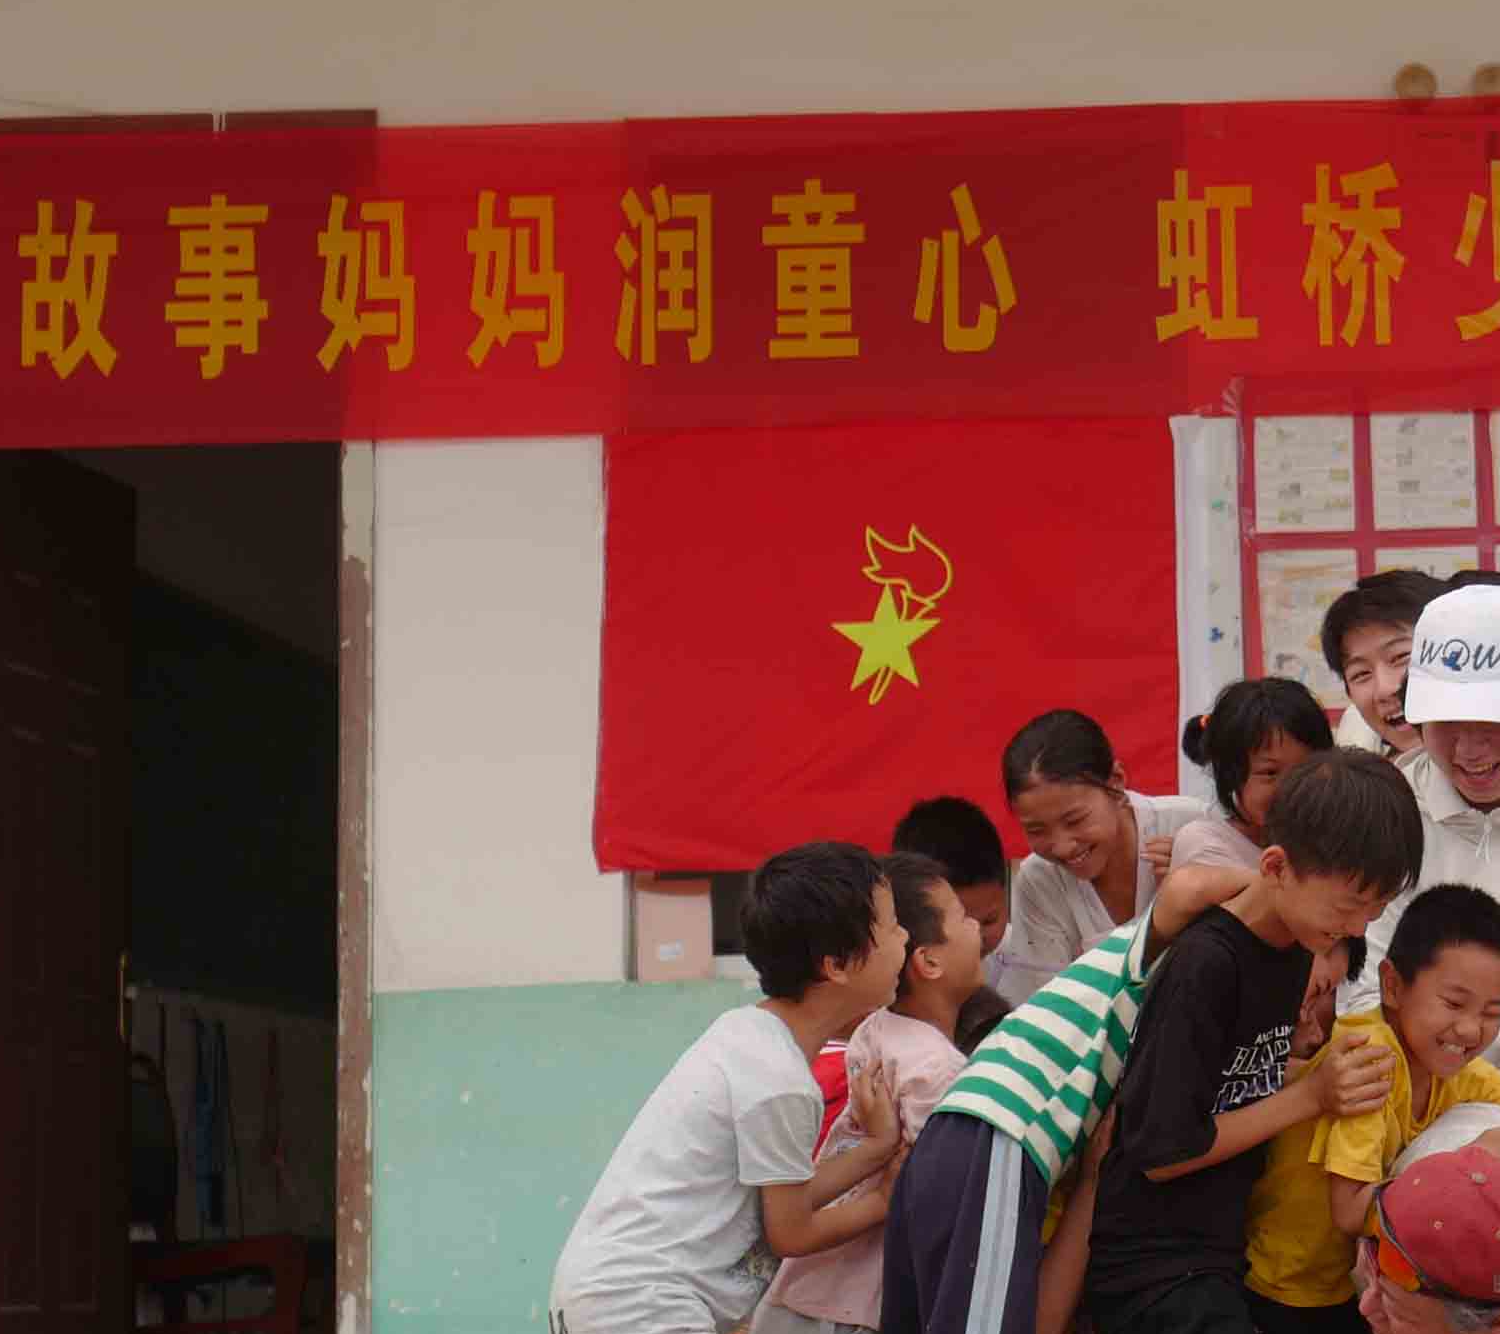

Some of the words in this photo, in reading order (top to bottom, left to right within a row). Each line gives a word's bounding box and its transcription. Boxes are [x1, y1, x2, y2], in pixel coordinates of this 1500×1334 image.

[17, 178, 1017, 380] 故事妈妈润童心
